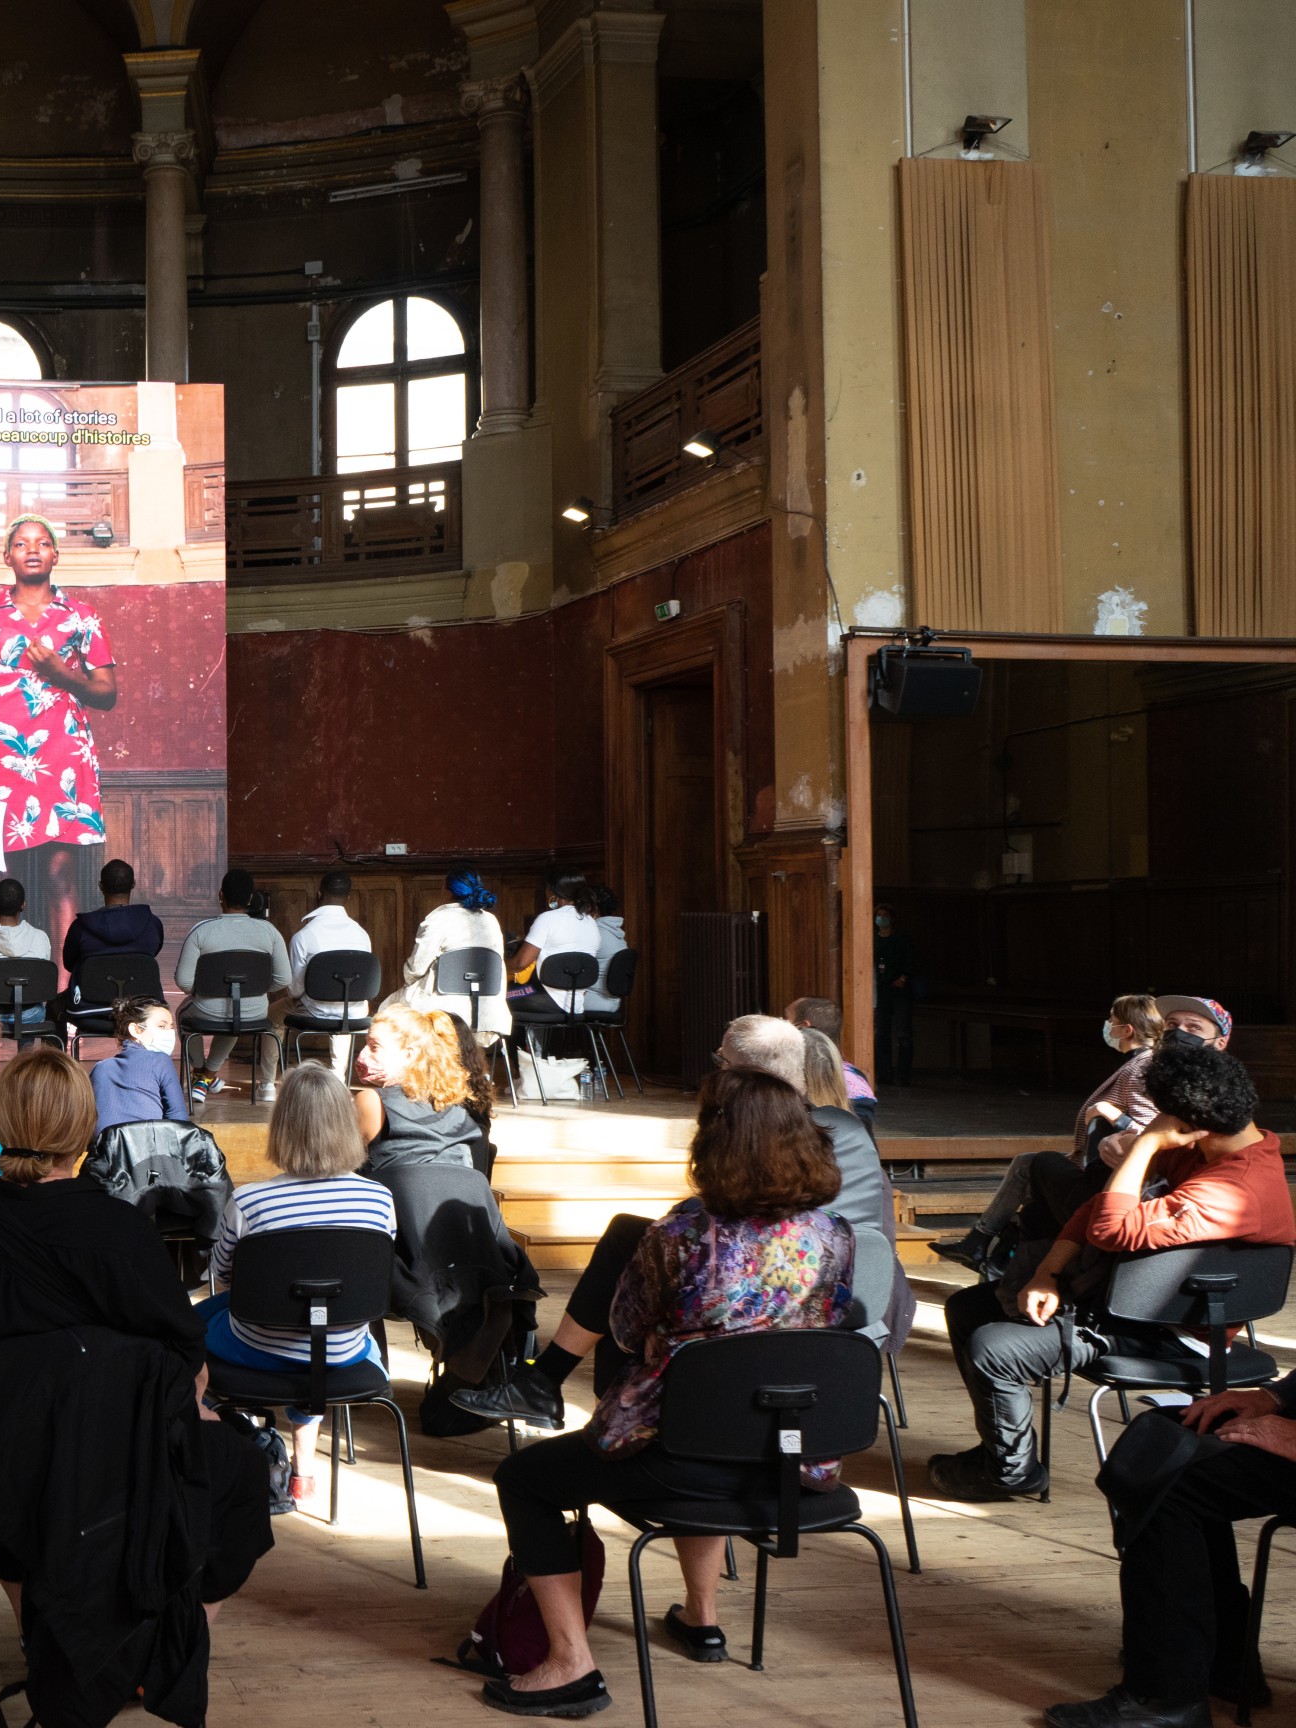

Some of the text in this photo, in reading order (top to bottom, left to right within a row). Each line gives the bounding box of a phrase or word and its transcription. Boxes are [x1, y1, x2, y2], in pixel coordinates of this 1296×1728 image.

[6, 411, 17, 423] a
[20, 408, 41, 424] lot
[43, 409, 61, 424] of
[64, 410, 117, 425] stories
[71, 429, 151, 445] d'histoires
